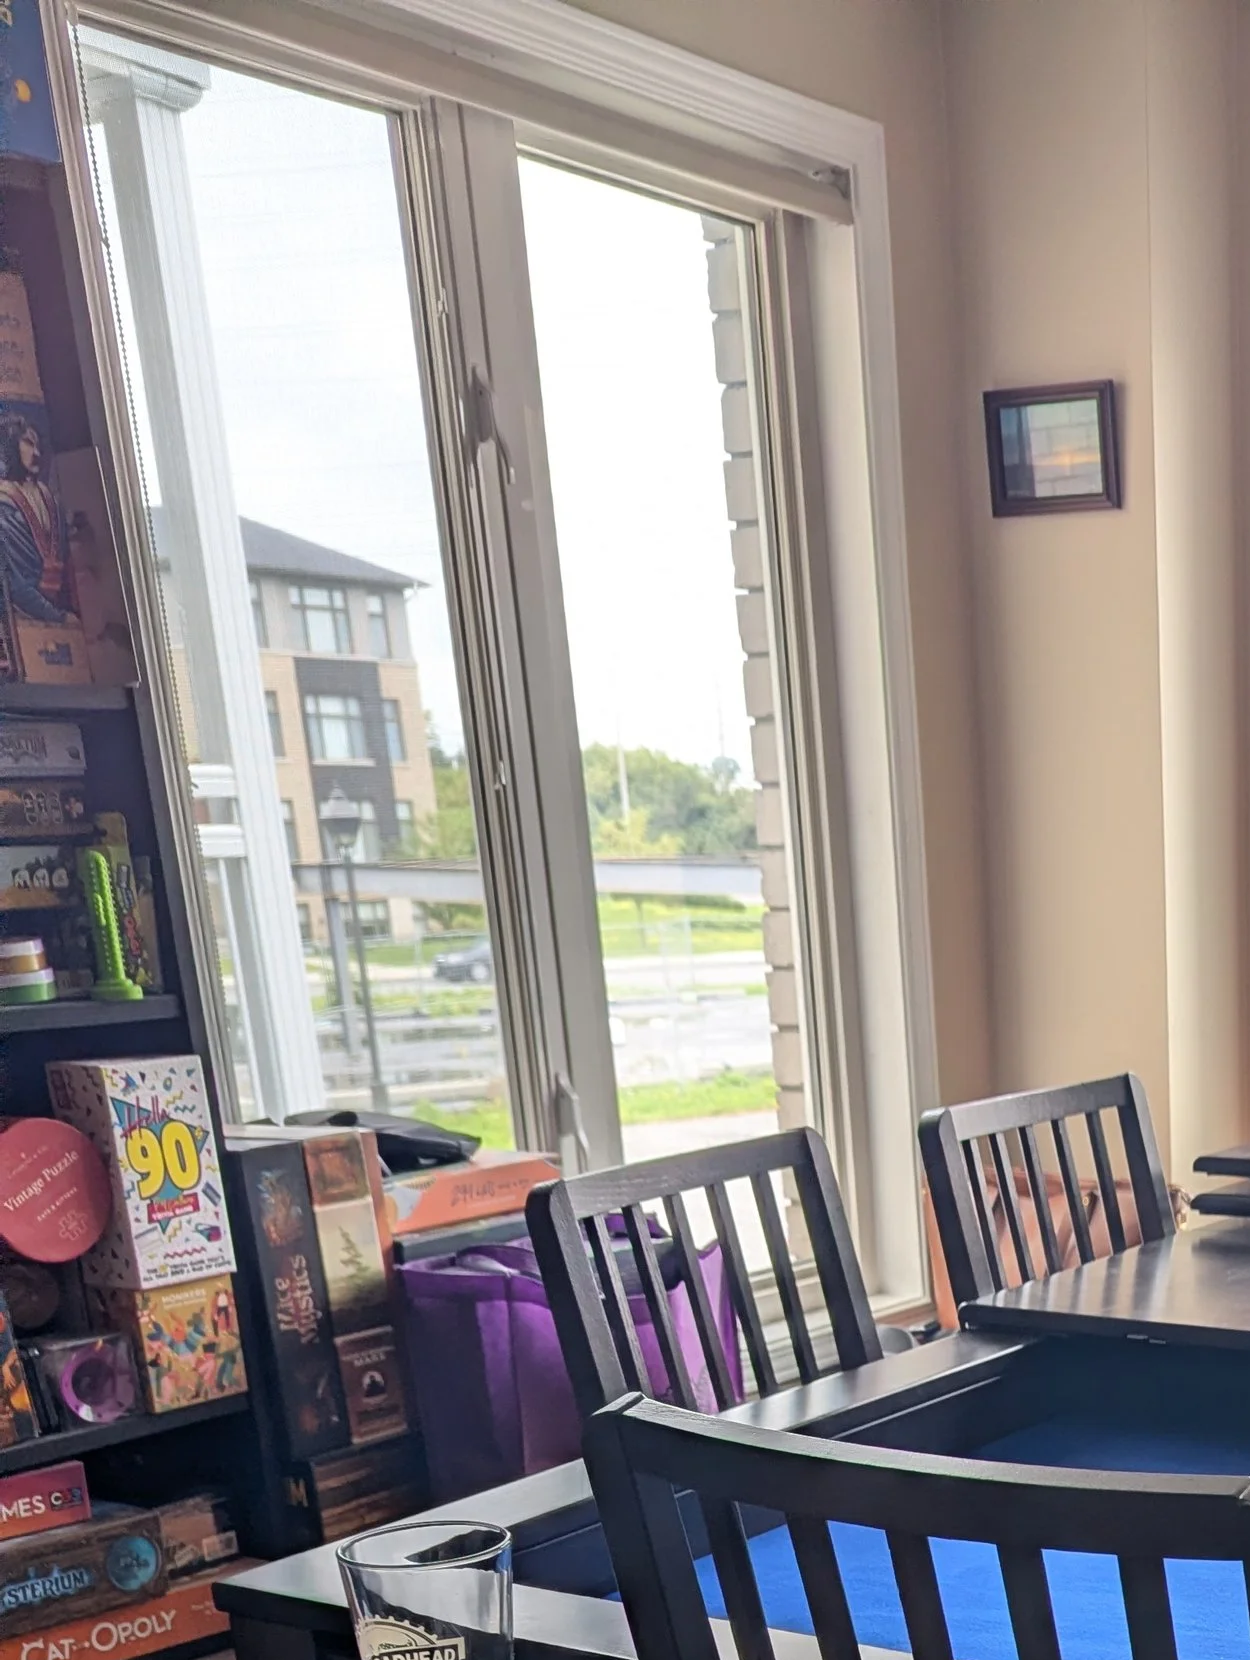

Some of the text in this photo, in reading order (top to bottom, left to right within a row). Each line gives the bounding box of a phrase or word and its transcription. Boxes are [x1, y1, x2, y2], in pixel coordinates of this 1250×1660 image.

[4, 1178, 45, 1212] Vintage
[42, 1150, 79, 1182] Puzzle
[290, 1254, 324, 1344] Mystics
[0, 1569, 86, 1606] STERIUM
